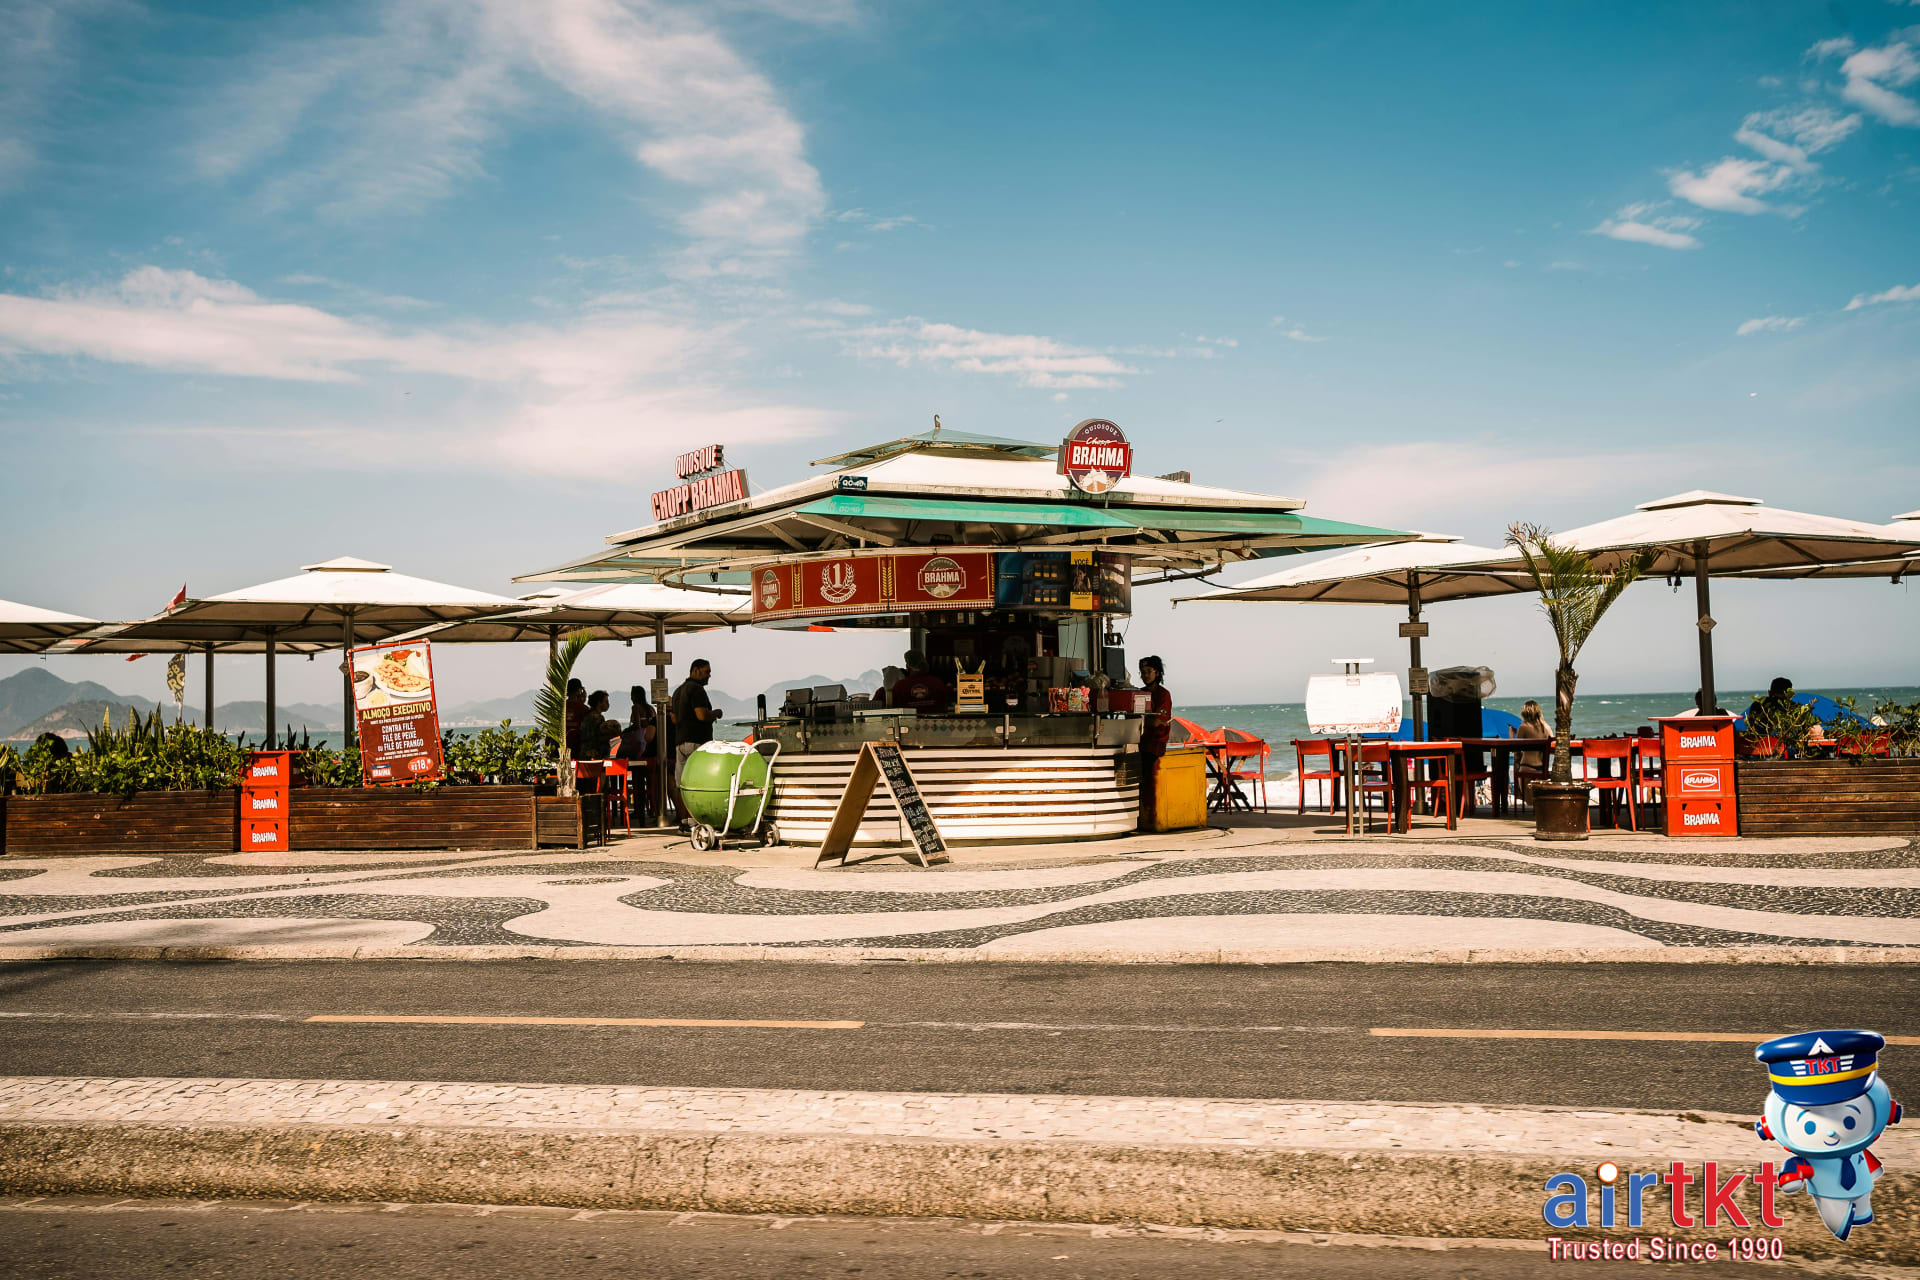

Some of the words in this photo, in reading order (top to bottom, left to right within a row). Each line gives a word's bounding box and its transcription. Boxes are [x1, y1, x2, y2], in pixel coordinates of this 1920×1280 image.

[1084, 423, 1118, 436] QUIOSQUE
[674, 444, 720, 480] QUIOSQUE
[1072, 445, 1124, 467] BRAHMA
[651, 484, 690, 521] CHOPP
[691, 469, 744, 511] BRAHMA
[924, 571, 960, 583] BRAHMA
[362, 708, 391, 720] ALMOÇO
[392, 702, 431, 716] EXECUTIVO
[381, 724, 402, 734] CONTRA
[1680, 735, 1717, 748] BRAHMA
[252, 766, 278, 777] BRAHMA
[1684, 776, 1718, 784] BRAHMA
[252, 798, 278, 810] BRAHMA
[1683, 812, 1720, 826] BRAHMA
[251, 831, 277, 843] BRAHMA
